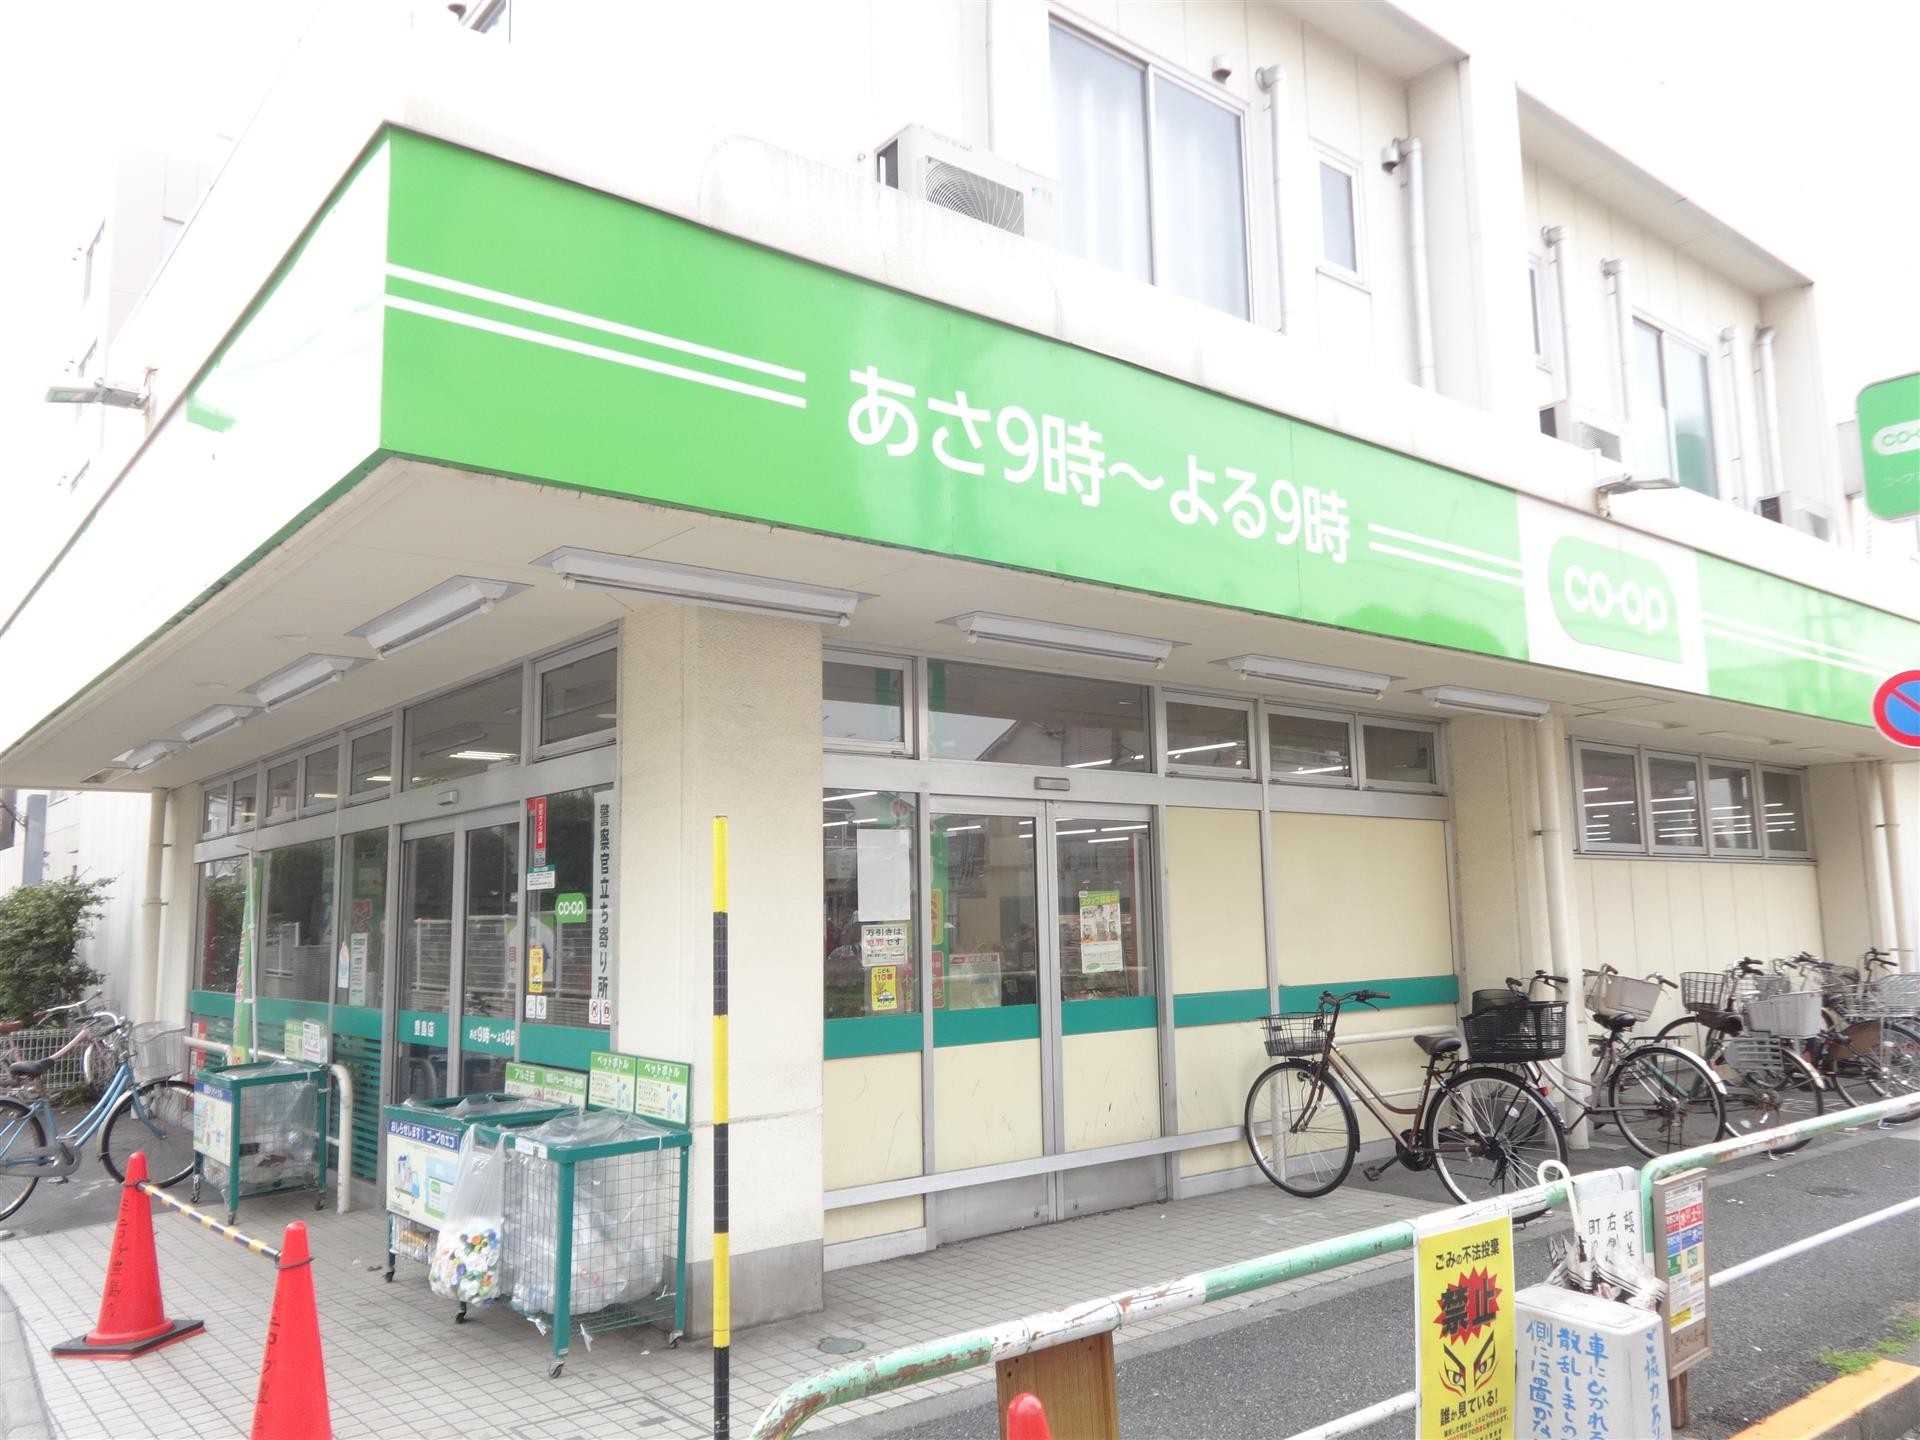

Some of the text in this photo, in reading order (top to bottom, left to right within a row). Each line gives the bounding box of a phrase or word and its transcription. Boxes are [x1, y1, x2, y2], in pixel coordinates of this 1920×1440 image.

[596, 1055, 631, 1072] ペットボトル
[643, 1062, 681, 1079] ペットボトル
[1435, 1237, 1500, 1271] ごみの不法投棄
[1440, 1278, 1498, 1337] 禁止
